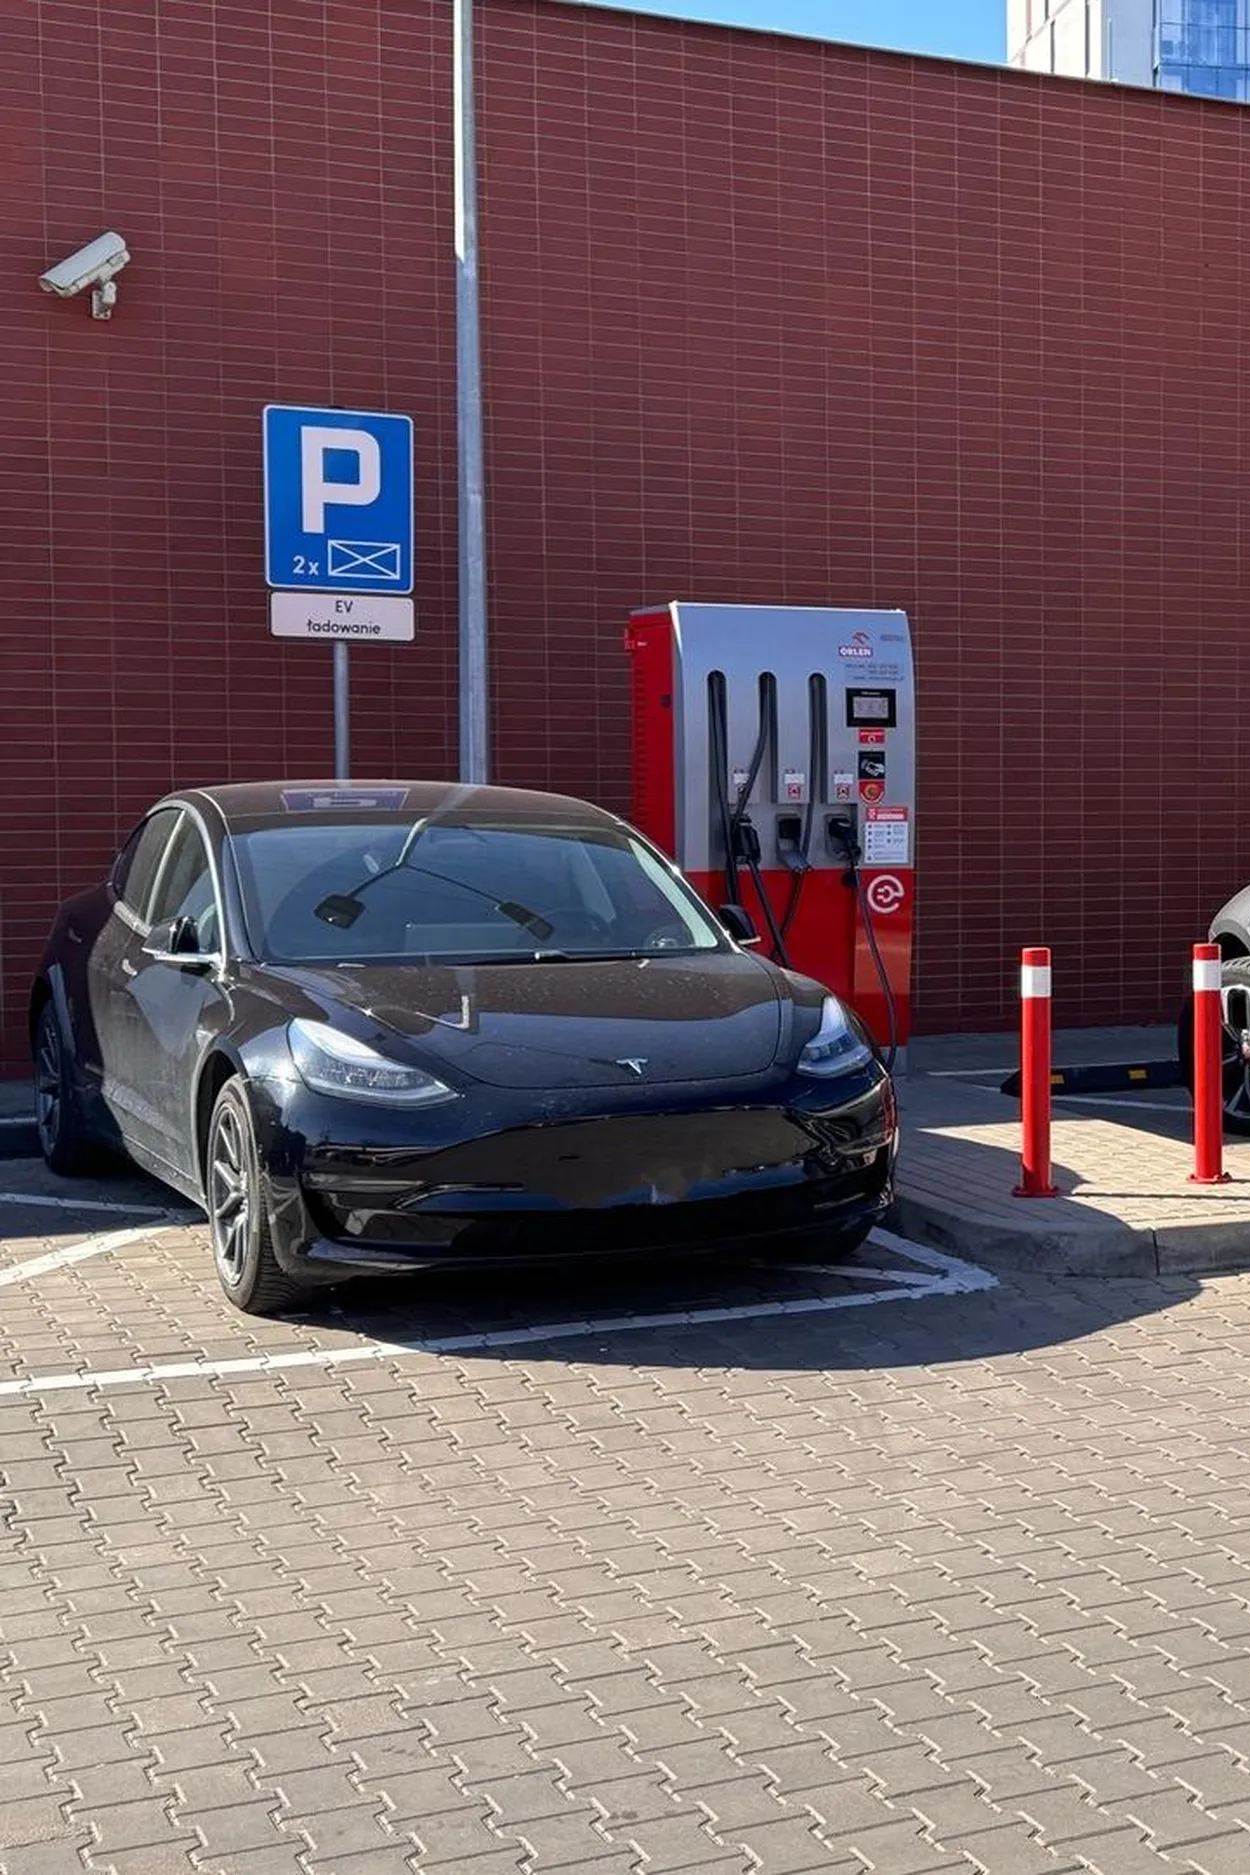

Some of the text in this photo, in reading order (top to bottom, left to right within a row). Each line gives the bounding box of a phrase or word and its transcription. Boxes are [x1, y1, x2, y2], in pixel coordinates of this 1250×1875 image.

[301, 426, 381, 534] P
[334, 599, 354, 613] EV
[306, 619, 381, 635] ładowanie
[839, 646, 872, 656] ORLEN
